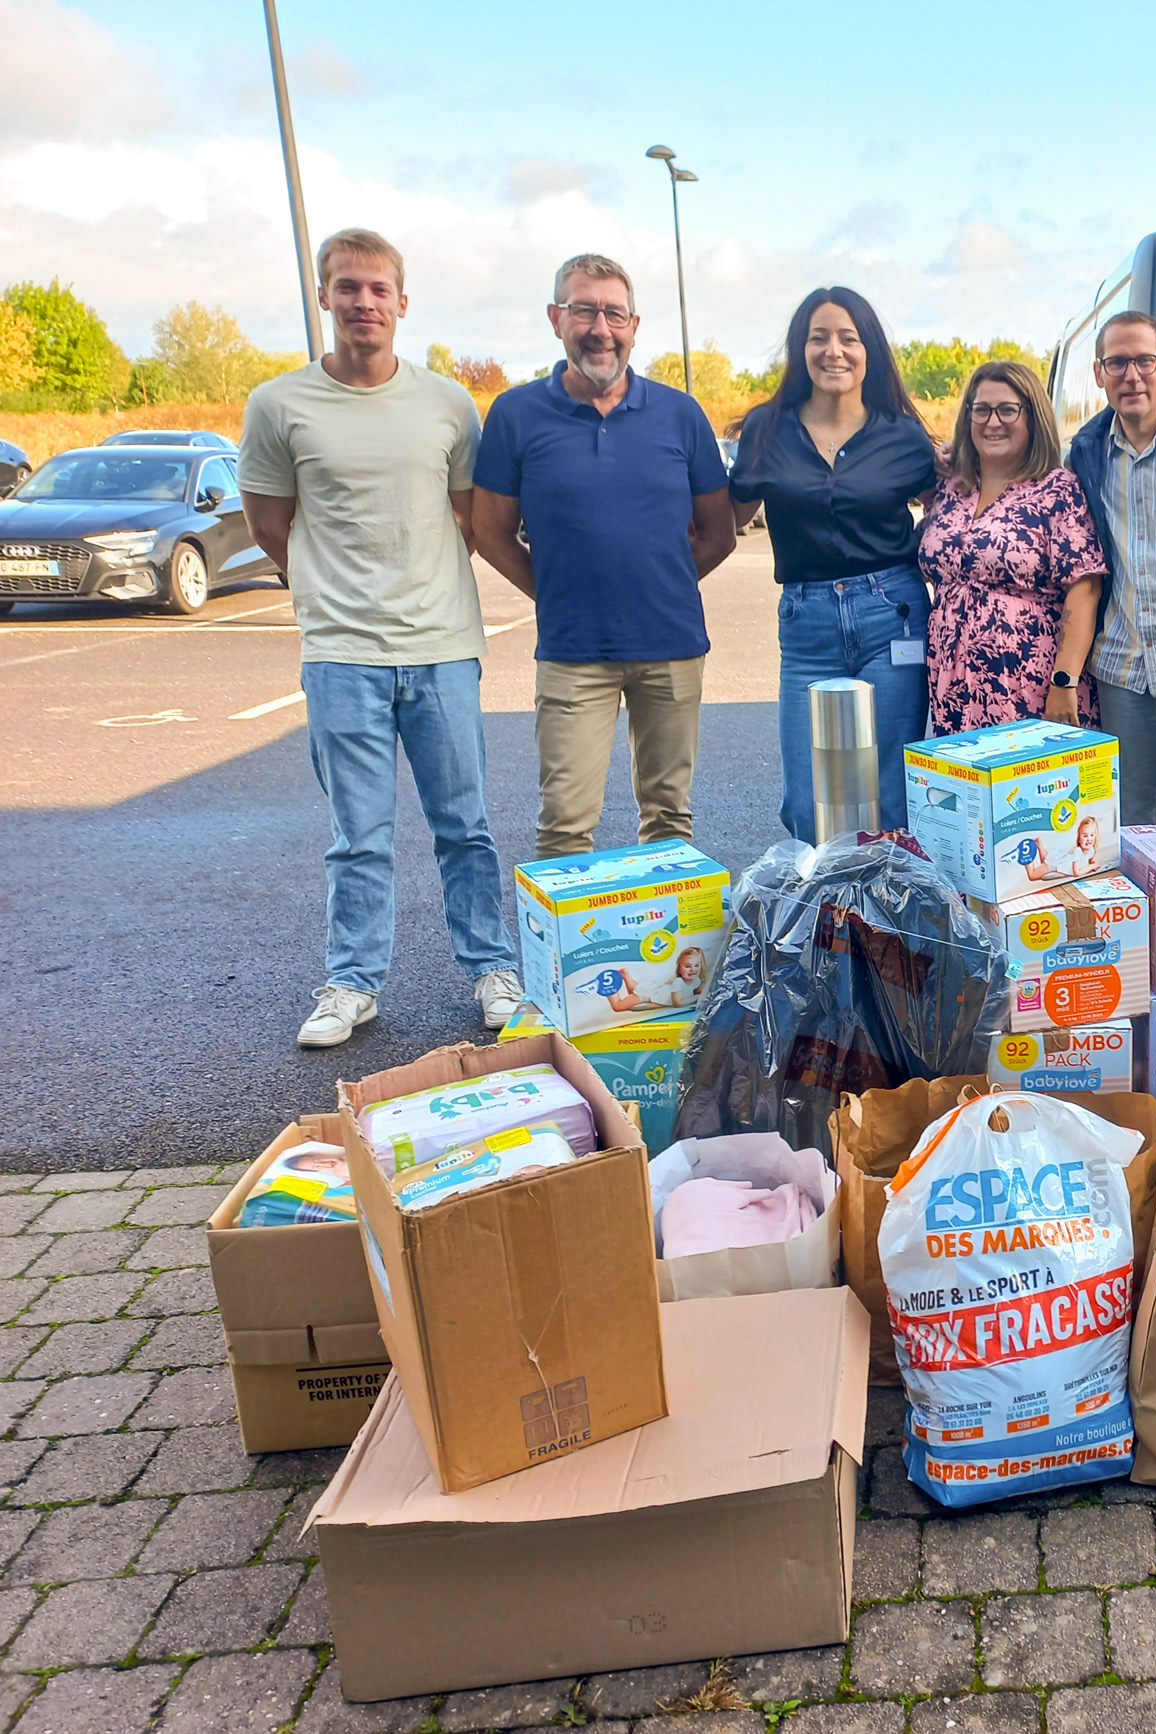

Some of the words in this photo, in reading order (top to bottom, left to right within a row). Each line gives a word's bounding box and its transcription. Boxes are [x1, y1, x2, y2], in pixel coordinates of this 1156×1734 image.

[910, 754, 927, 767] JUMBO
[928, 760, 938, 770] BOX
[1062, 752, 1084, 765] JUMBO
[1084, 748, 1097, 760] BOX
[948, 766, 967, 779] JUMBO
[968, 770, 980, 782] BOX
[1012, 762, 1036, 776] JUMBO
[1036, 760, 1050, 770] BOX
[908, 772, 928, 786] lupilu
[1037, 779, 1069, 794] lupilu
[1000, 820, 1017, 828] Luiers
[1021, 813, 1042, 824] Couches
[1022, 840, 1030, 854] 5
[654, 882, 683, 896] JUMBO
[684, 879, 701, 890] BOX
[588, 894, 619, 908] JUMBO
[620, 890, 638, 901] BOX
[620, 910, 664, 926] lupilu
[1066, 904, 1142, 928] JUMBO
[1028, 920, 1051, 936] 92
[574, 950, 594, 960] Luiers
[600, 944, 629, 954] Couches
[1046, 950, 1117, 968] babylove
[604, 972, 613, 986] 5
[1054, 969, 1110, 981] PREMIUM-WINDELN
[1055, 987, 1070, 1006] 3
[1006, 1041, 1029, 1056] 92
[1044, 1052, 1092, 1067] PACK
[1024, 1074, 1100, 1091] babylove
[434, 1150, 476, 1170] lupilu
[409, 1175, 451, 1195] Premium
[925, 1161, 1092, 1231] ESPACE
[926, 1232, 974, 1258] DES
[982, 1218, 1095, 1254] MARQUES
[900, 1298, 911, 1312] LA
[910, 1289, 945, 1310] MODE
[951, 1288, 964, 1305] &
[970, 1288, 984, 1302] LE
[987, 1269, 1040, 1298] SPORT
[1046, 1267, 1054, 1285] À
[298, 1375, 362, 1390] PROPERTY
[365, 1374, 380, 1384] OF
[309, 1391, 334, 1401] FOR
[337, 1386, 382, 1399] INTERN
[1013, 1390, 1046, 1404] ANGOULINS
[980, 1401, 992, 1409] YON
[1056, 1432, 1084, 1446] Notre
[1087, 1422, 1123, 1440] boutique
[528, 1430, 591, 1460] FRAGILE
[927, 1438, 1133, 1484] espace-des-marques.c
